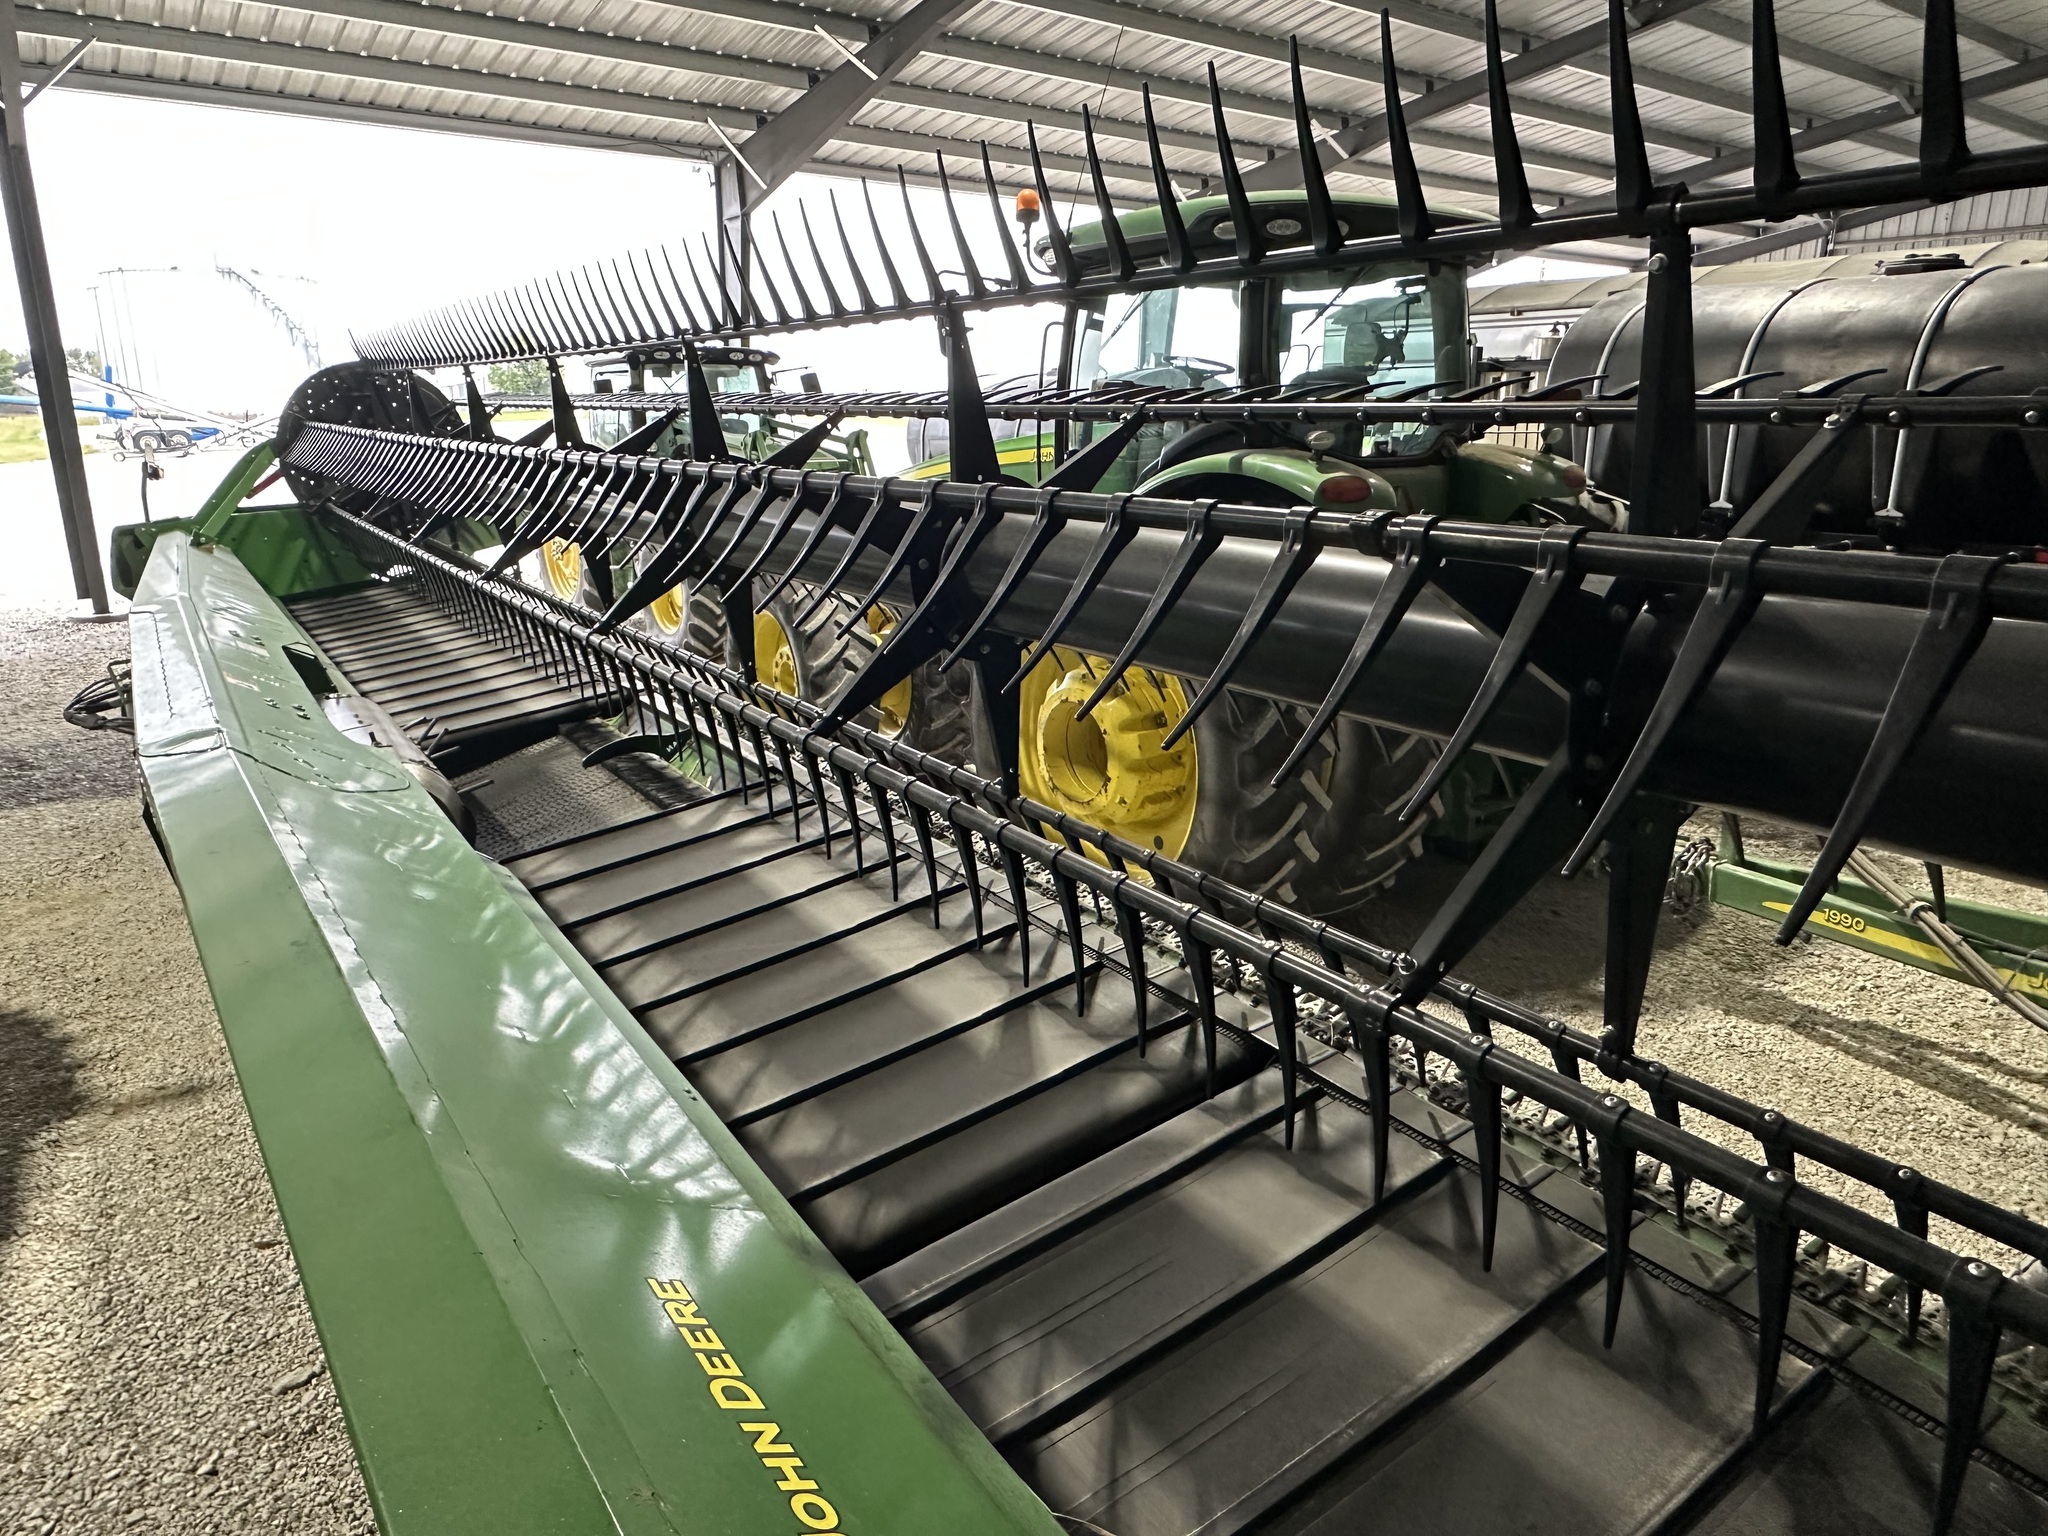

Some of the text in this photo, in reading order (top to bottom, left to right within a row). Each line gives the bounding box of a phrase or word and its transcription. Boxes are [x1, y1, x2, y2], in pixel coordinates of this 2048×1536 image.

[1823, 908, 1866, 931] 1990
[646, 1277, 845, 1536] OHN DEERE
